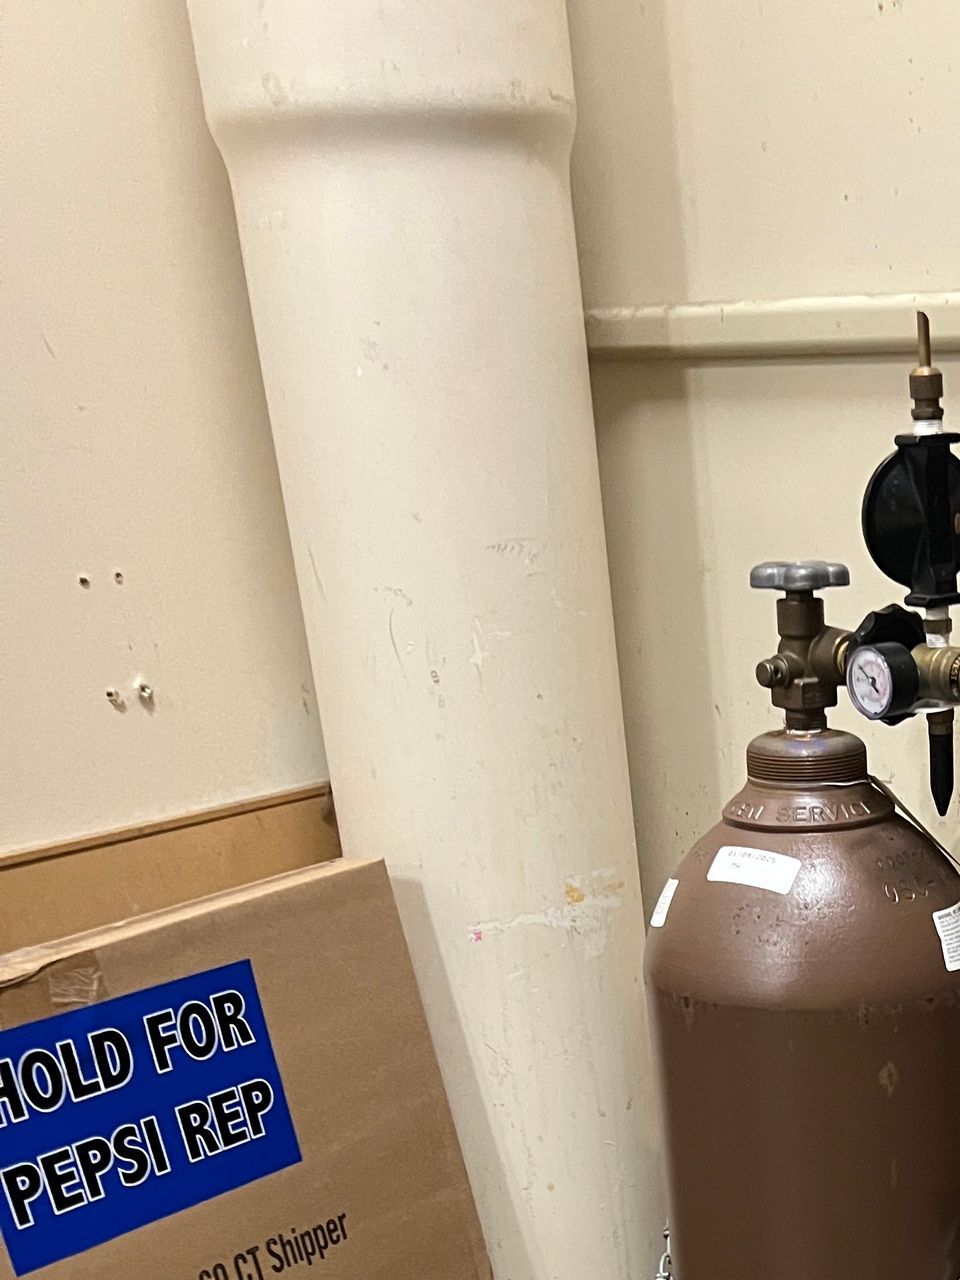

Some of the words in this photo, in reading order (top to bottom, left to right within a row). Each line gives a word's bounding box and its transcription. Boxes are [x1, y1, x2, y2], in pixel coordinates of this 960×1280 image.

[0, 1028, 134, 1128] HOLD
[143, 989, 256, 1073] FOR
[1, 1115, 172, 1230] PEPSI
[175, 1078, 274, 1163] REP
[270, 1211, 349, 1274] Shipper
